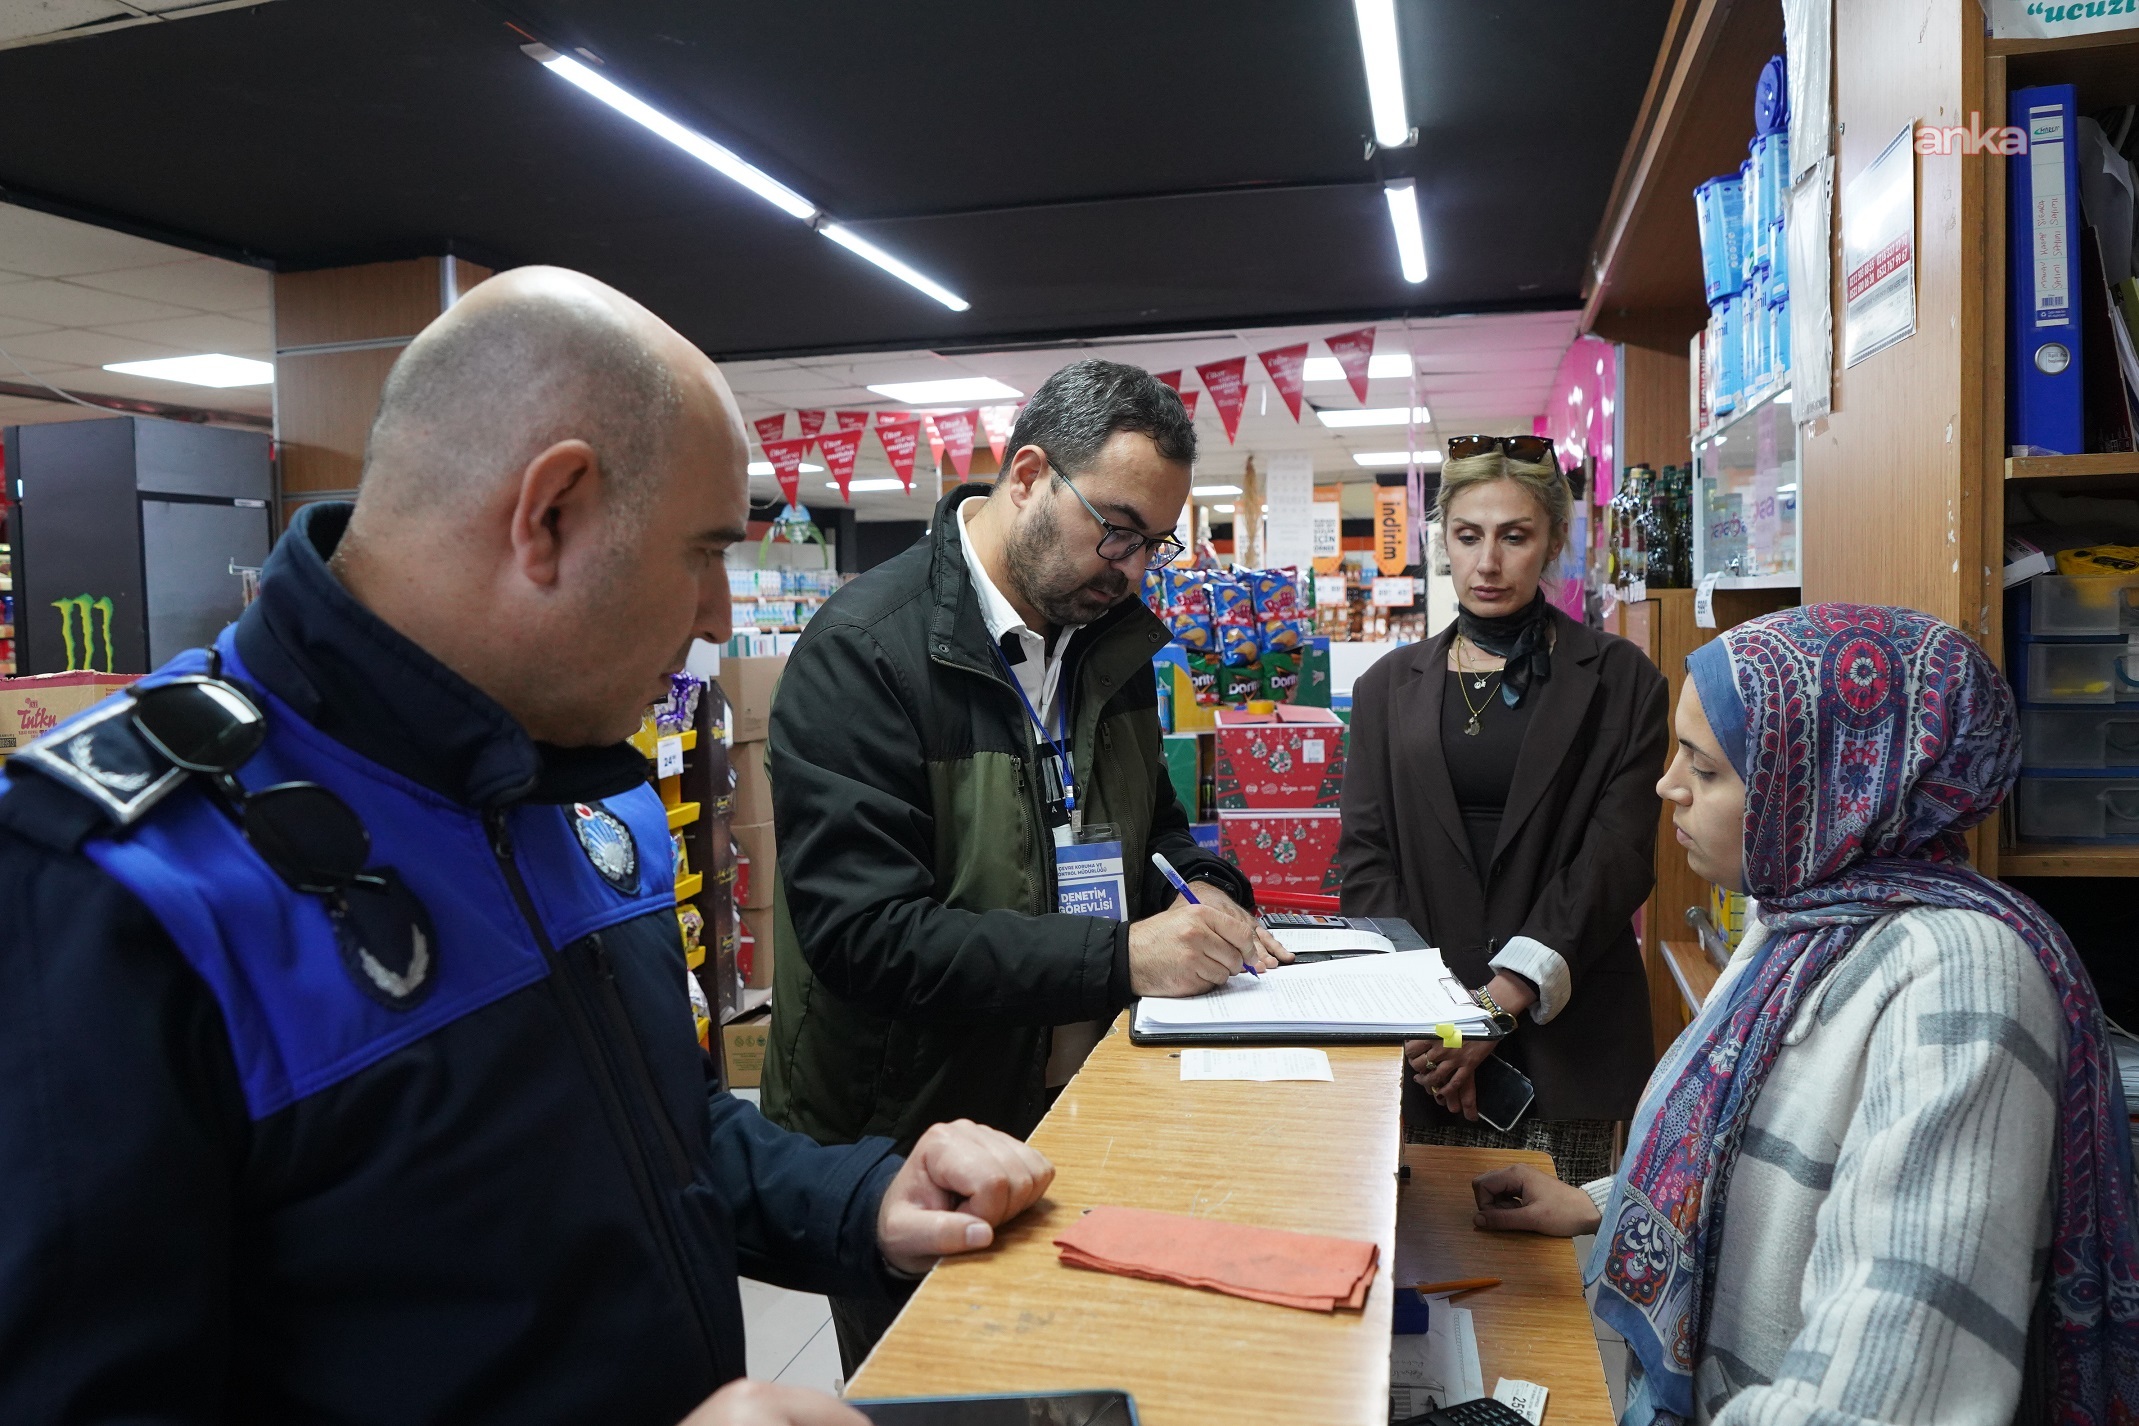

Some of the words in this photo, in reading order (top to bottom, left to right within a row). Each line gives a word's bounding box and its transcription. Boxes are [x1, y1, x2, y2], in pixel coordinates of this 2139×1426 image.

[1382, 502, 1402, 560] indirim
[17, 708, 58, 730] Tutku
[1060, 886, 1106, 903] DENETİM
[1058, 898, 1113, 914] GÖREVLİSİ
